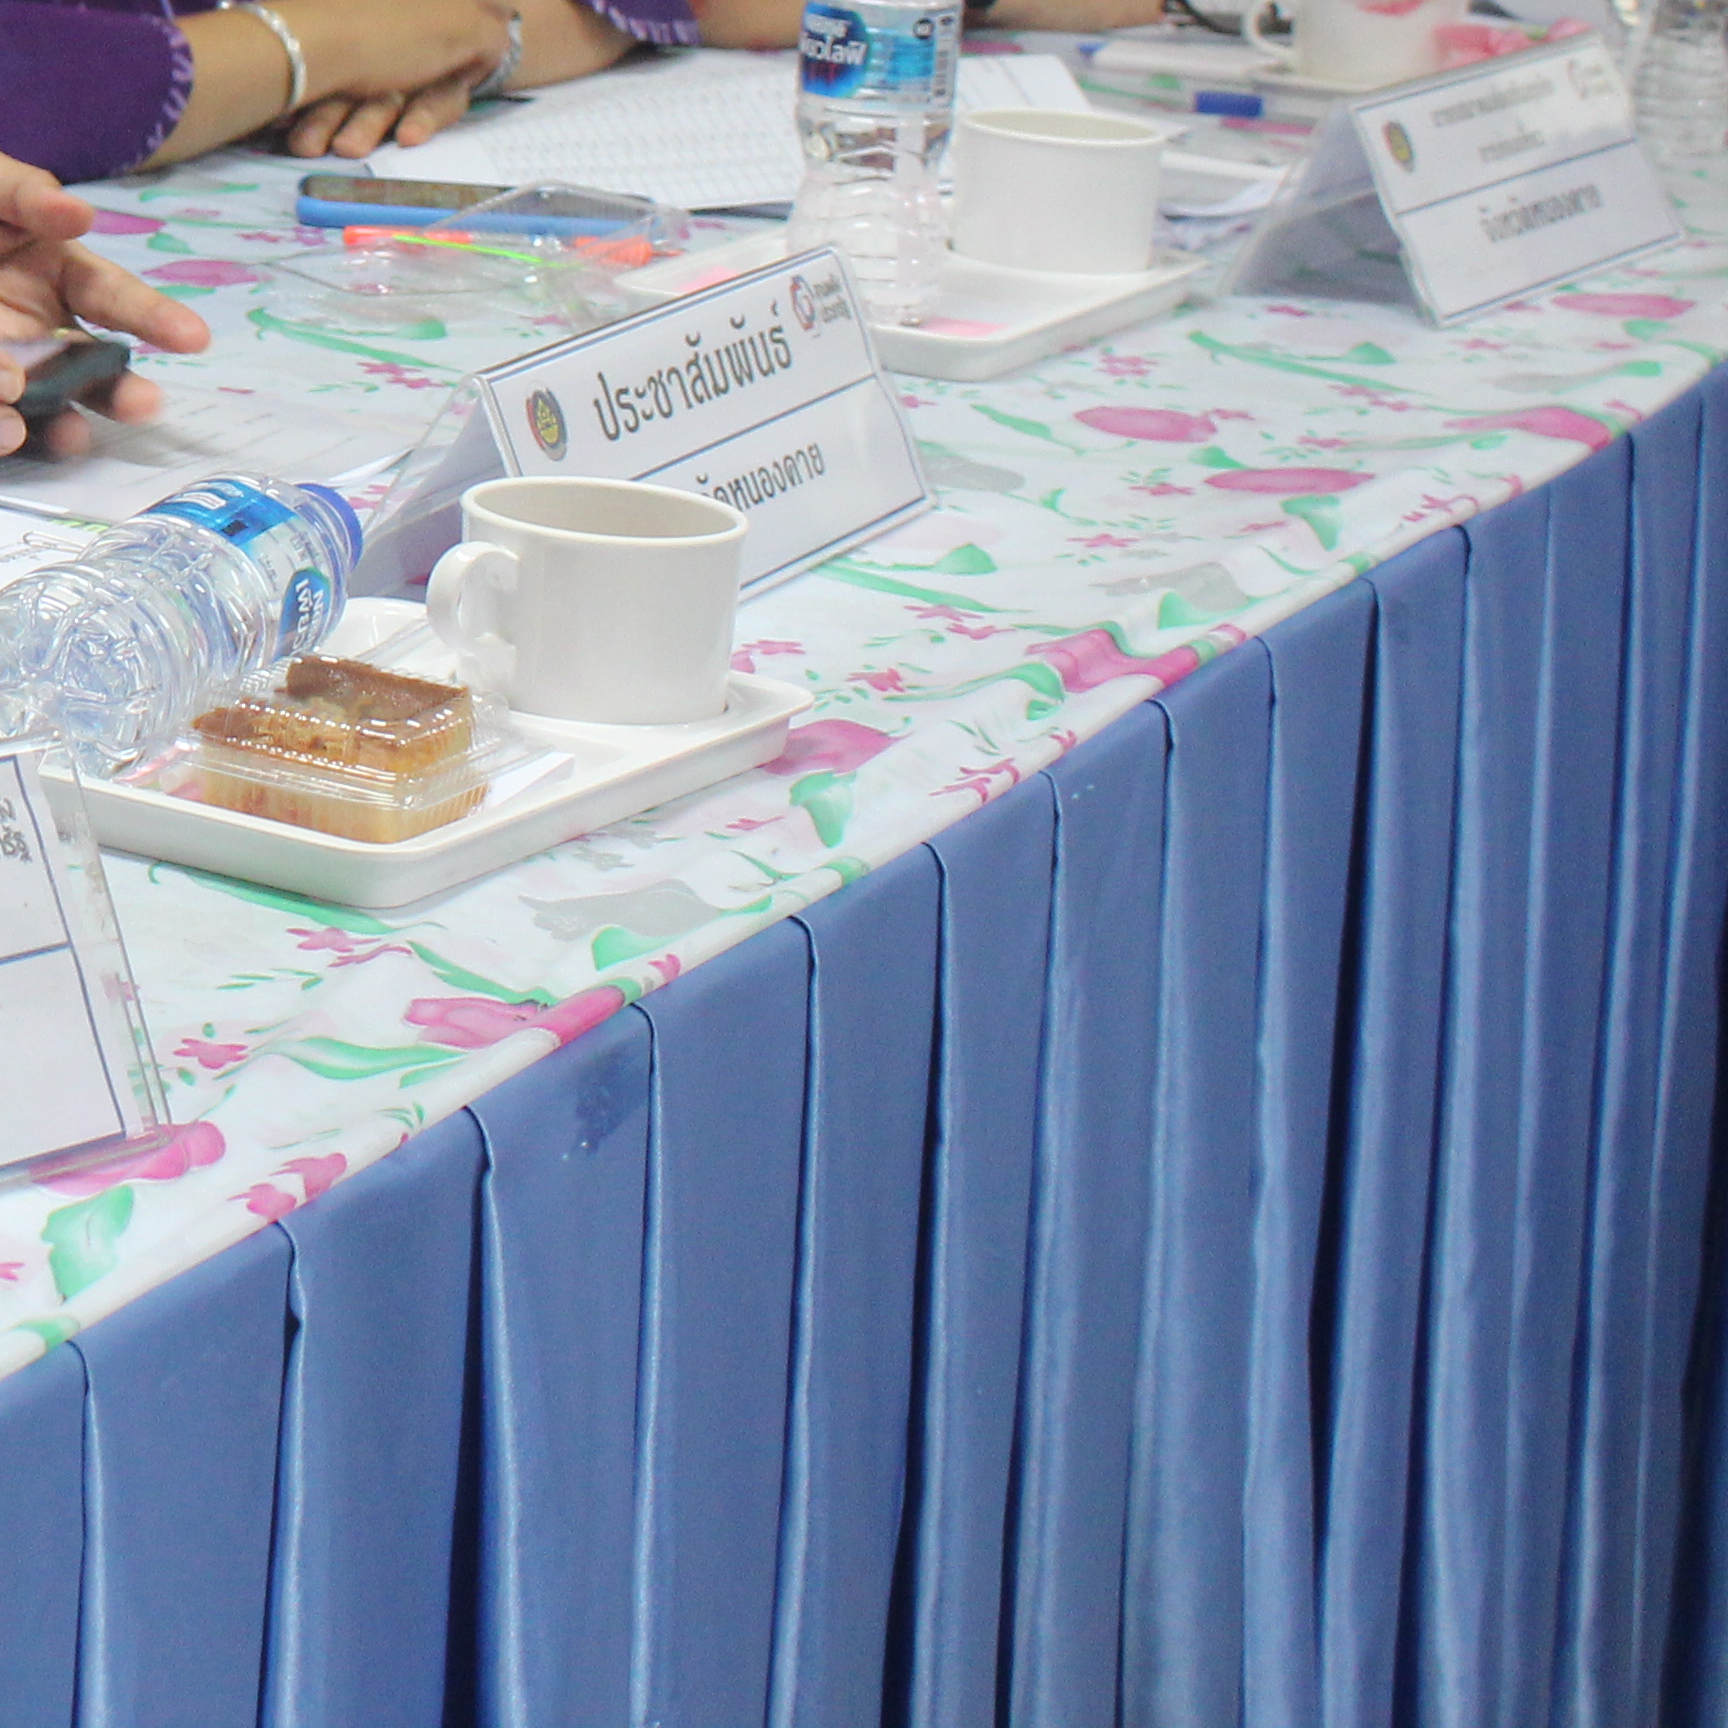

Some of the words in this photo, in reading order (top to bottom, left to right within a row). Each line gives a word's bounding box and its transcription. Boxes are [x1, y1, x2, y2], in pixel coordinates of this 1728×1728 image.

[594, 299, 793, 441] ประชาสัมพันธ์
